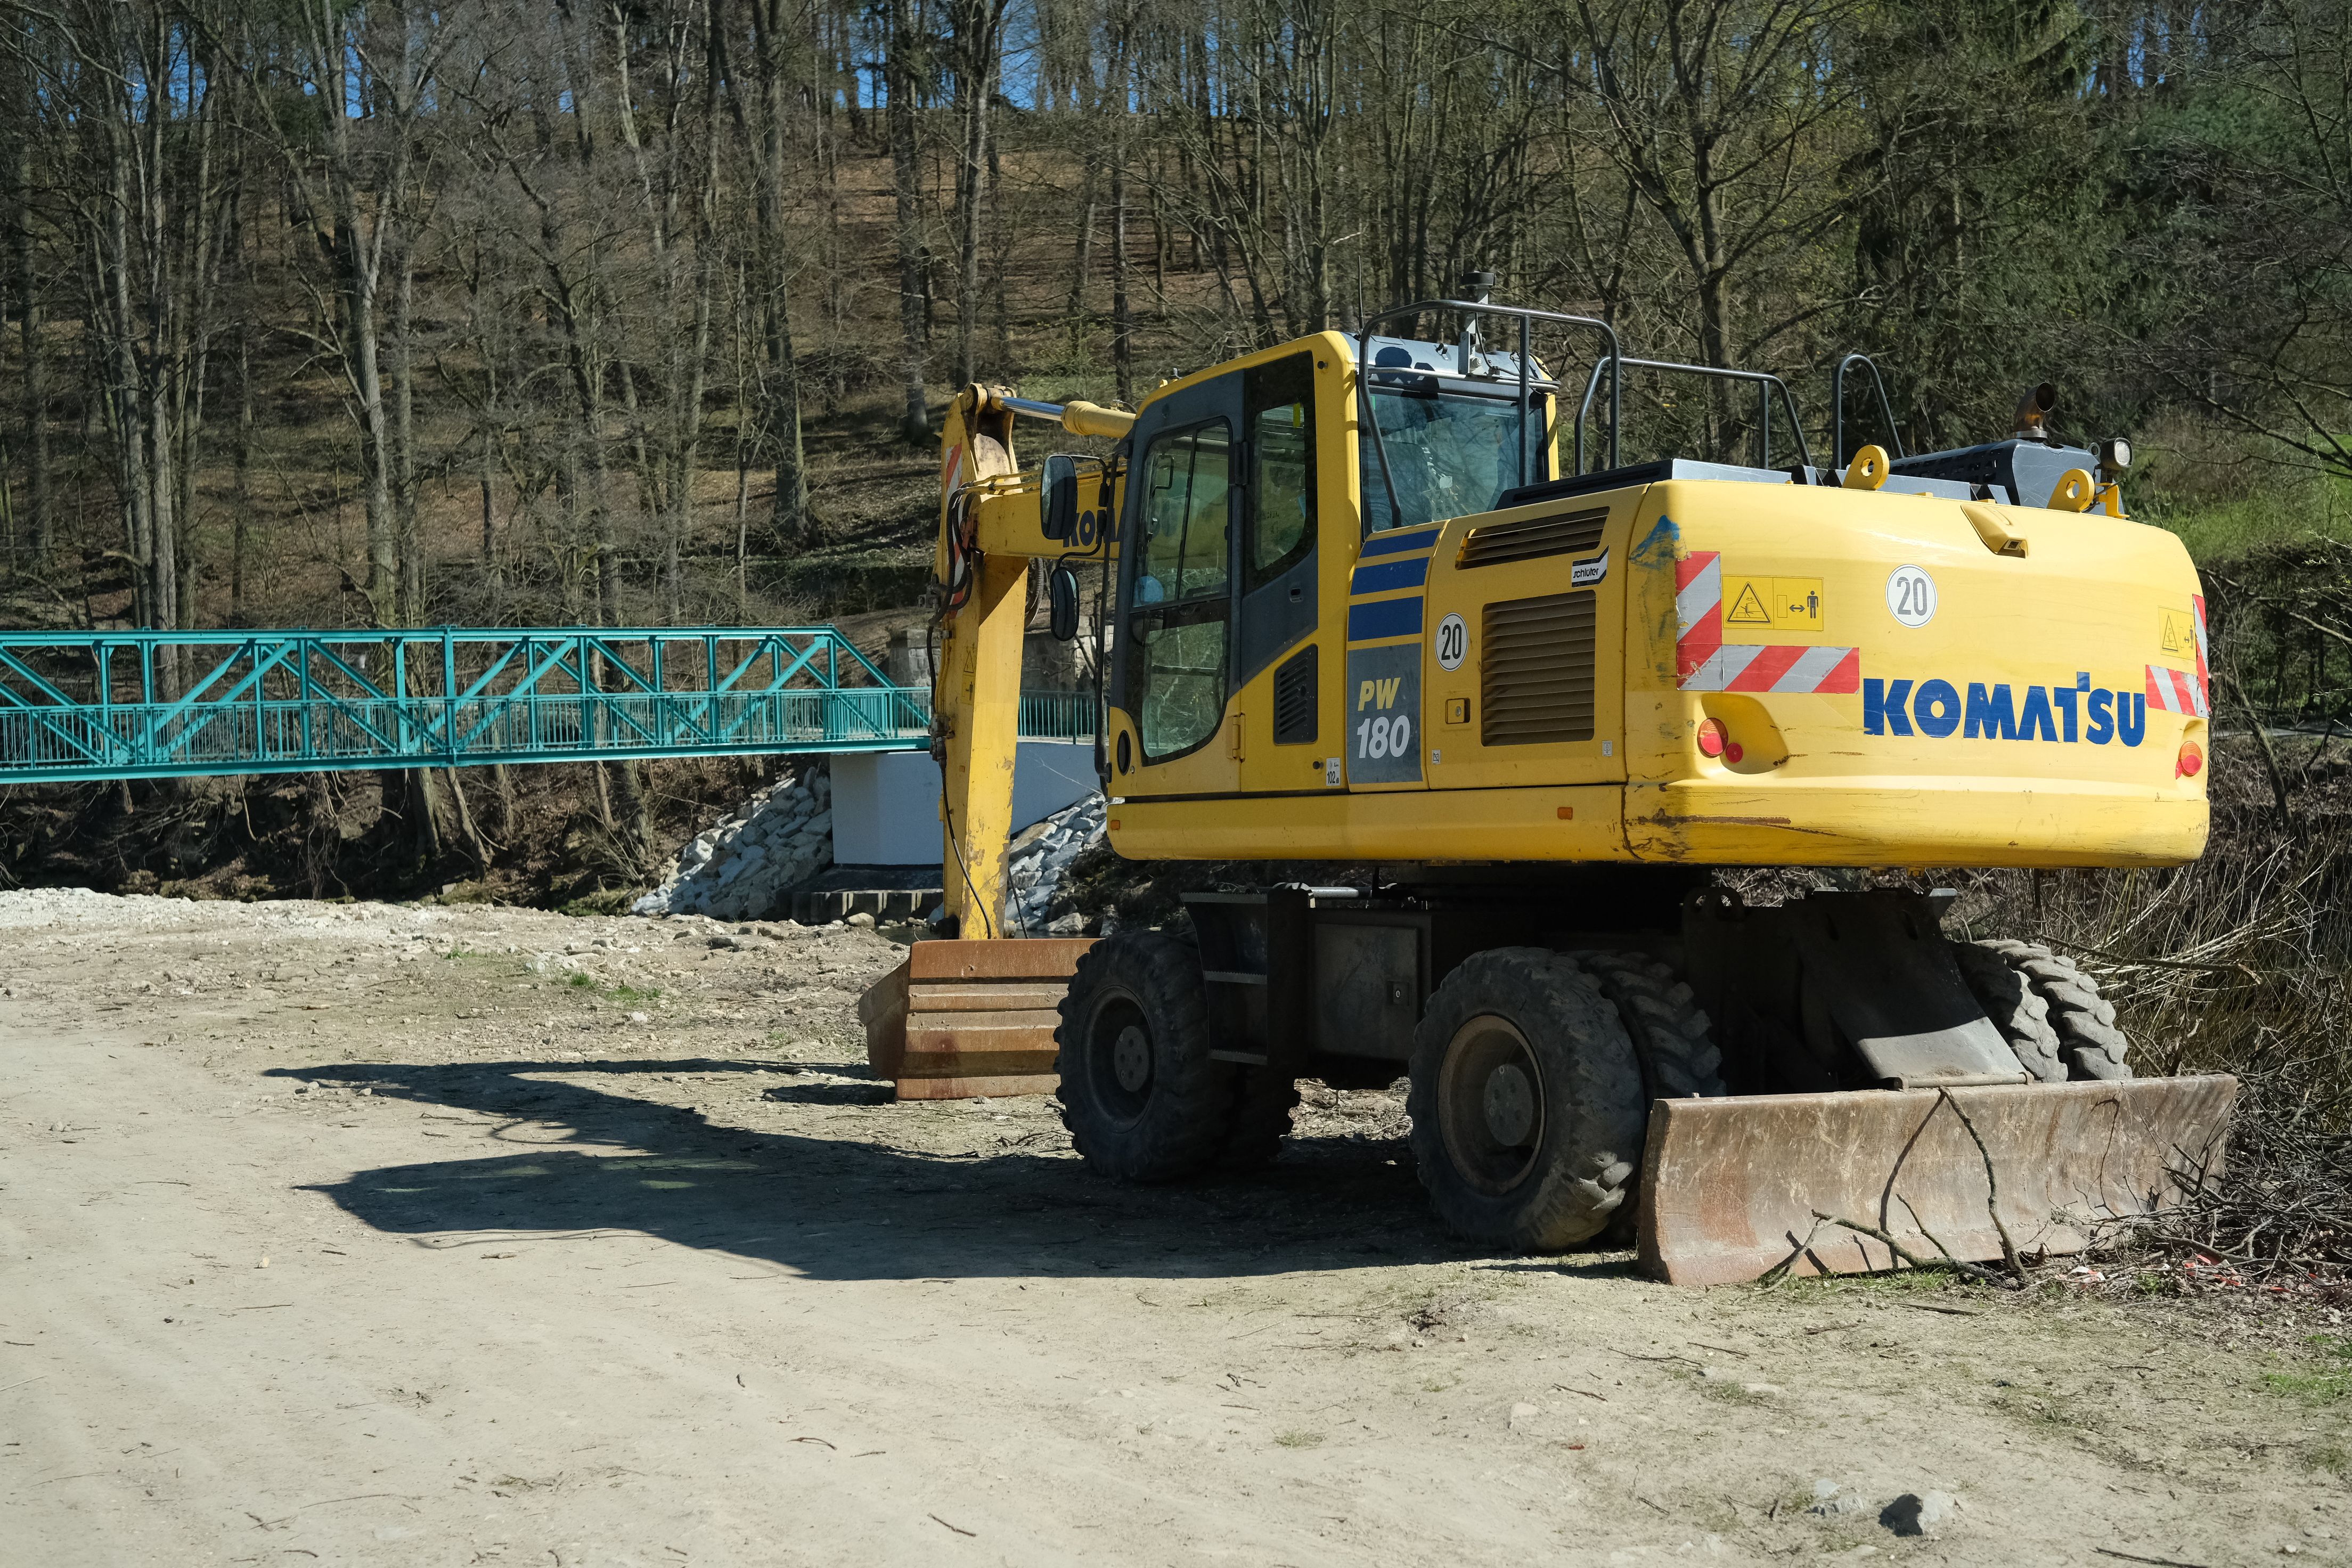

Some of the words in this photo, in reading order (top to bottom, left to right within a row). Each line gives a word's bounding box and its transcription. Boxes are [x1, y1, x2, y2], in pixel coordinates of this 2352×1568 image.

[1897, 576, 1928, 616] 20
[1441, 623, 1462, 660] 20
[1358, 677, 1401, 711] PW
[1863, 672, 2145, 747] KOMATSU
[1357, 715, 1410, 758] 180
